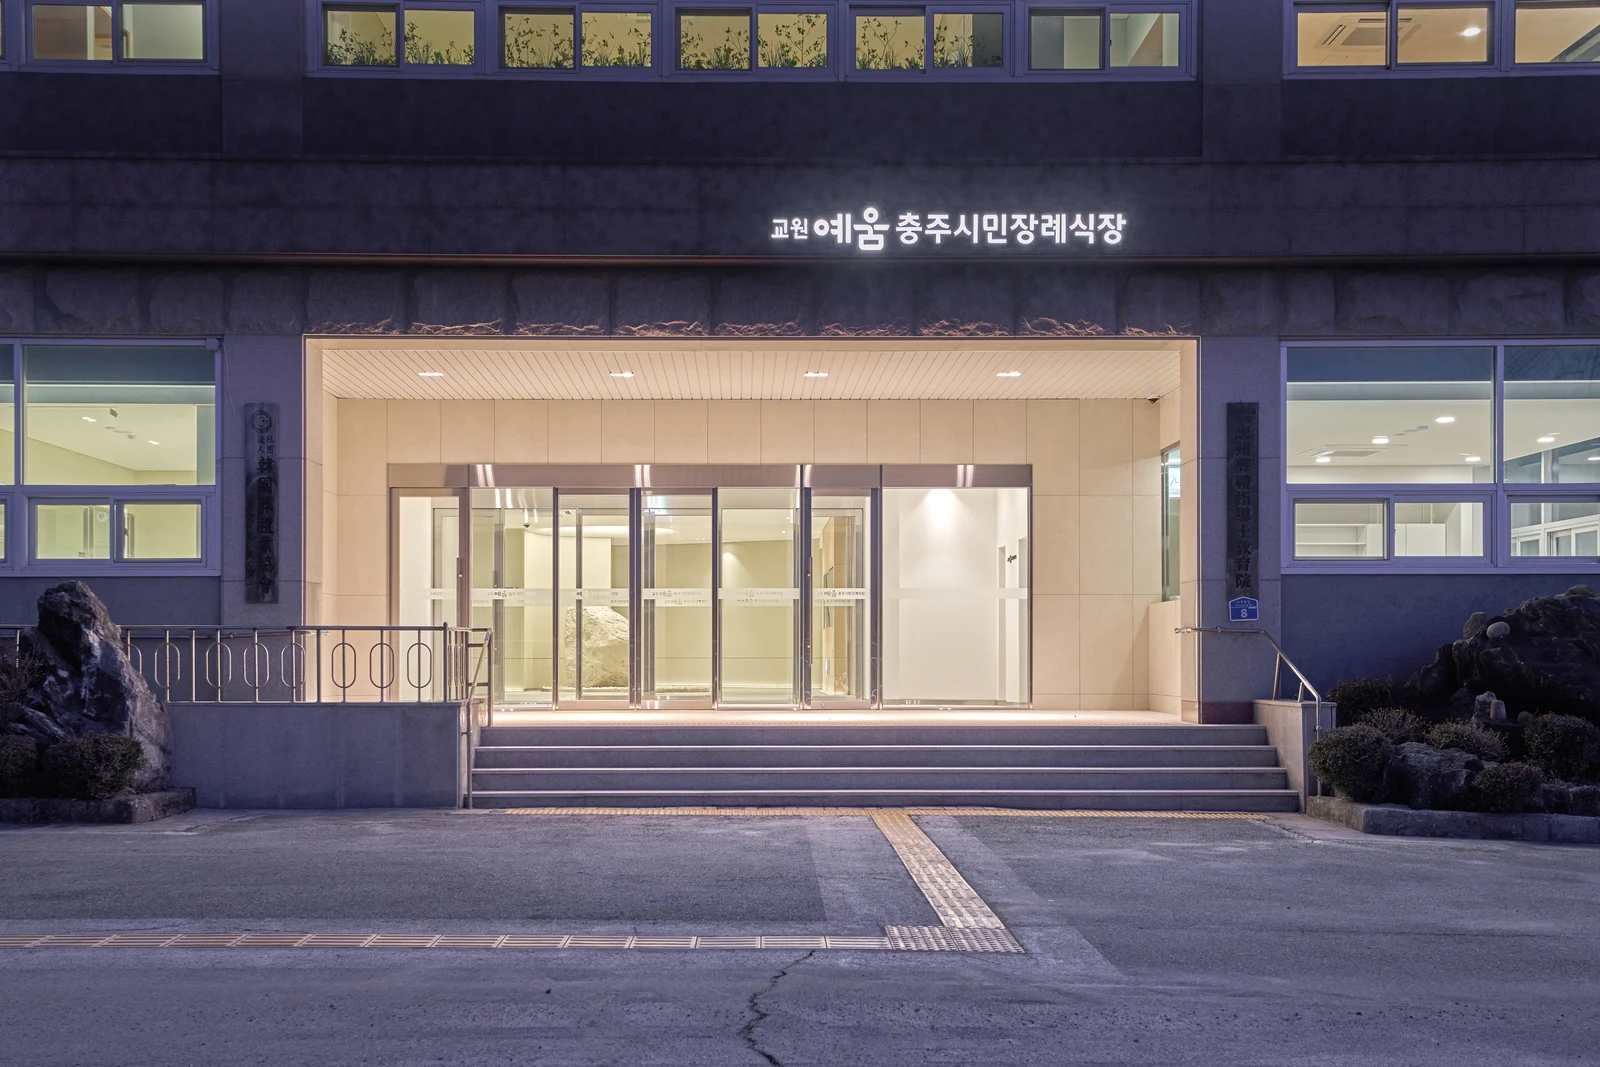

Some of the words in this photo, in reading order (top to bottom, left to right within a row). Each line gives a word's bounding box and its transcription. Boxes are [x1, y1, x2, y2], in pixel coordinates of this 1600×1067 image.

[771, 217, 808, 240] 교원
[813, 206, 890, 251] 예움
[895, 212, 1127, 245] 충주시민장례식장
[1240, 608, 1248, 618] 8
